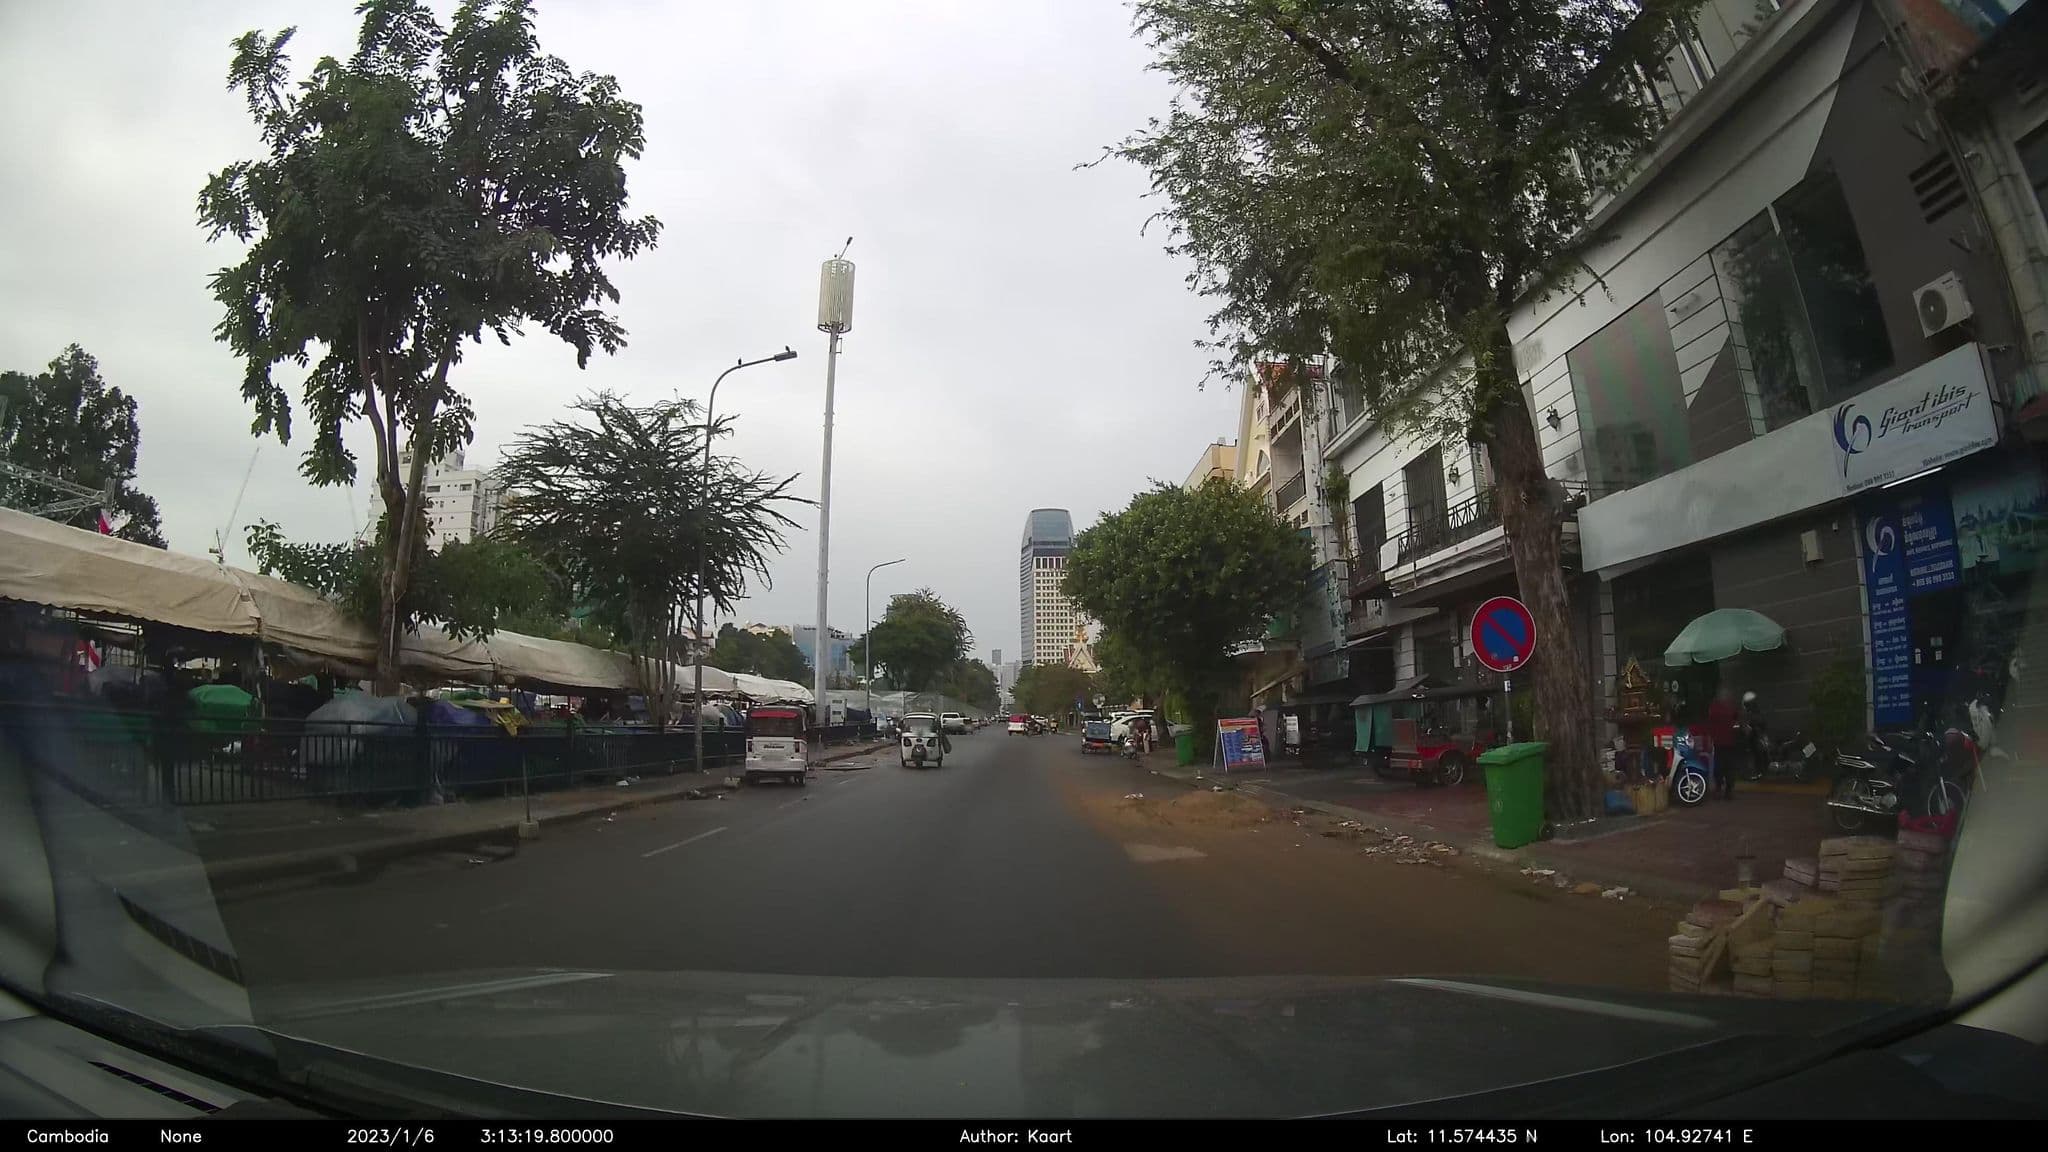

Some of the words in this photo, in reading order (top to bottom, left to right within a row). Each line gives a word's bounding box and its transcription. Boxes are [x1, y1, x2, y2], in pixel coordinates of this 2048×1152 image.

[1878, 391, 1931, 438] Giant
[1931, 384, 1967, 408] ibis
[1902, 392, 1980, 434] transport
